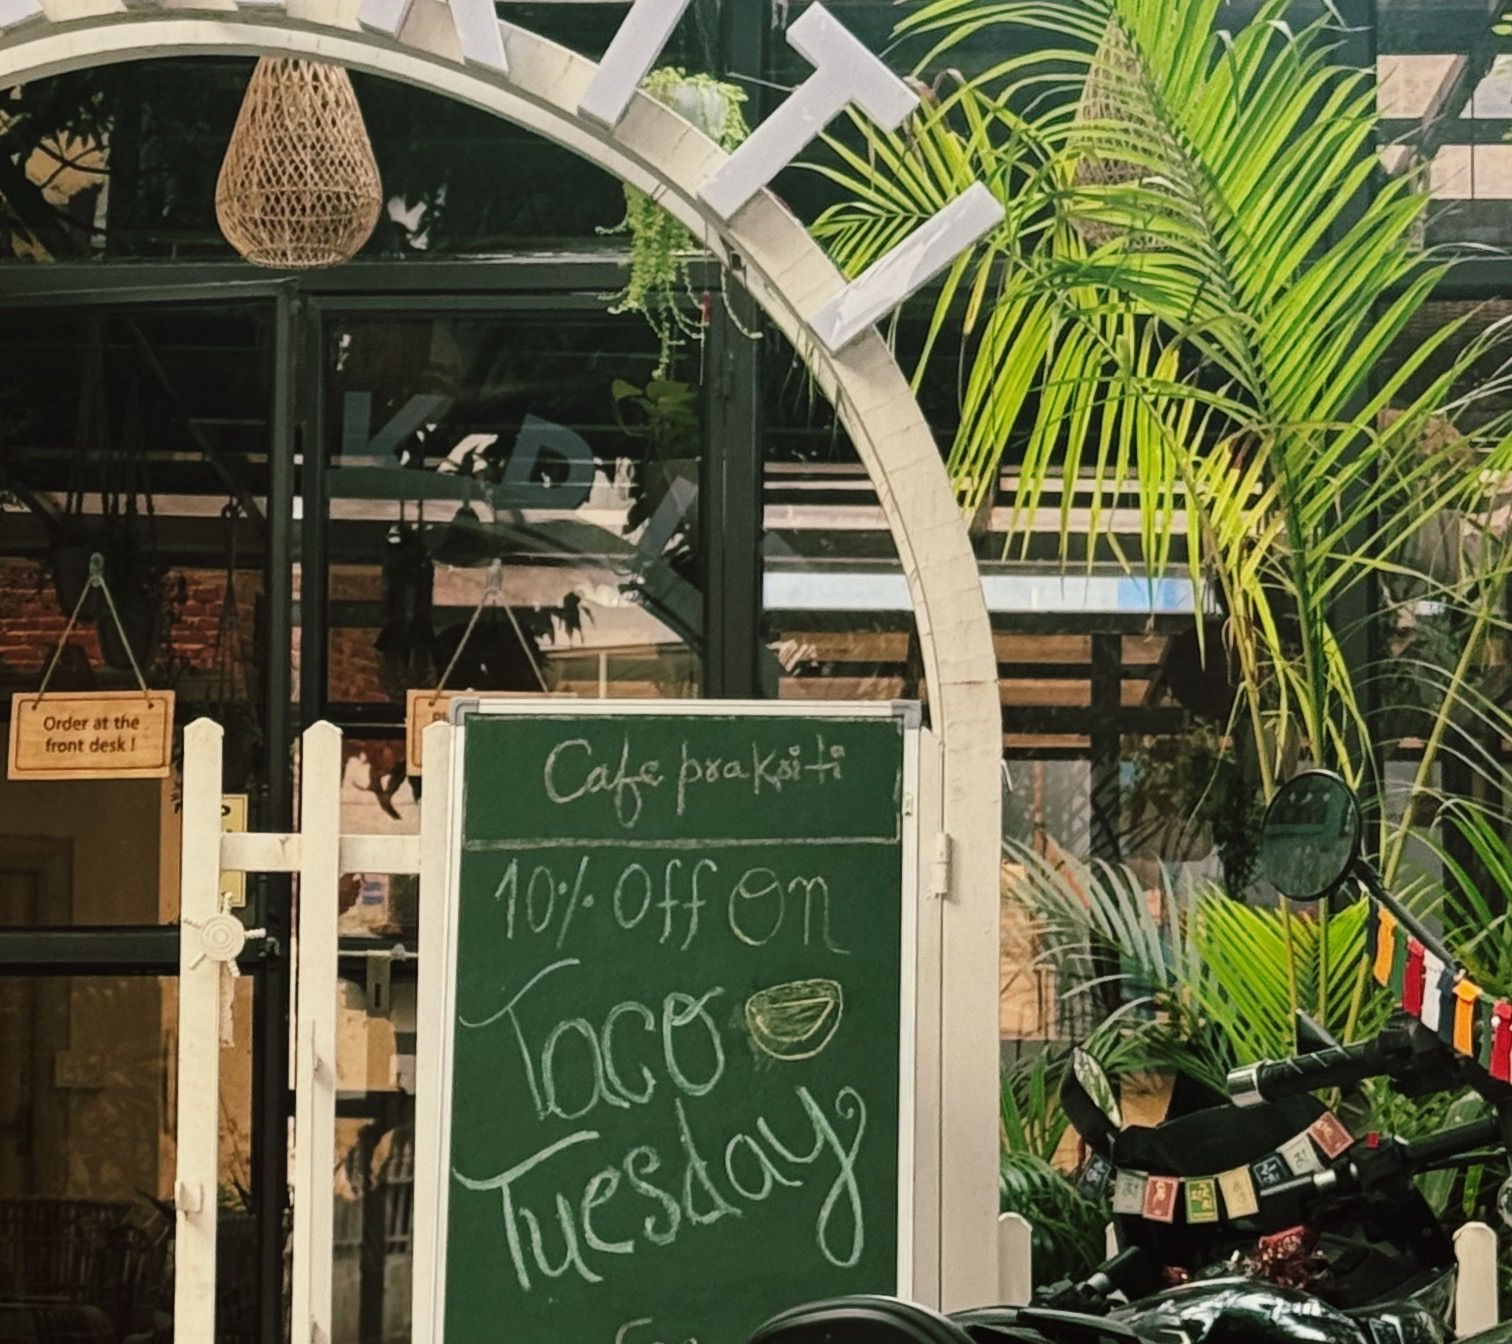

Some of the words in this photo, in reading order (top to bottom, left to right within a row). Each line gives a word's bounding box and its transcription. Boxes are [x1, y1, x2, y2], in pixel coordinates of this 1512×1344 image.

[43, 716, 89, 732] Order
[93, 717, 109, 731] at
[114, 714, 140, 730] the
[45, 736, 84, 753] front
[89, 735, 126, 753] desk
[494, 856, 596, 949] 10%
[451, 1086, 868, 1293] Tuesday
